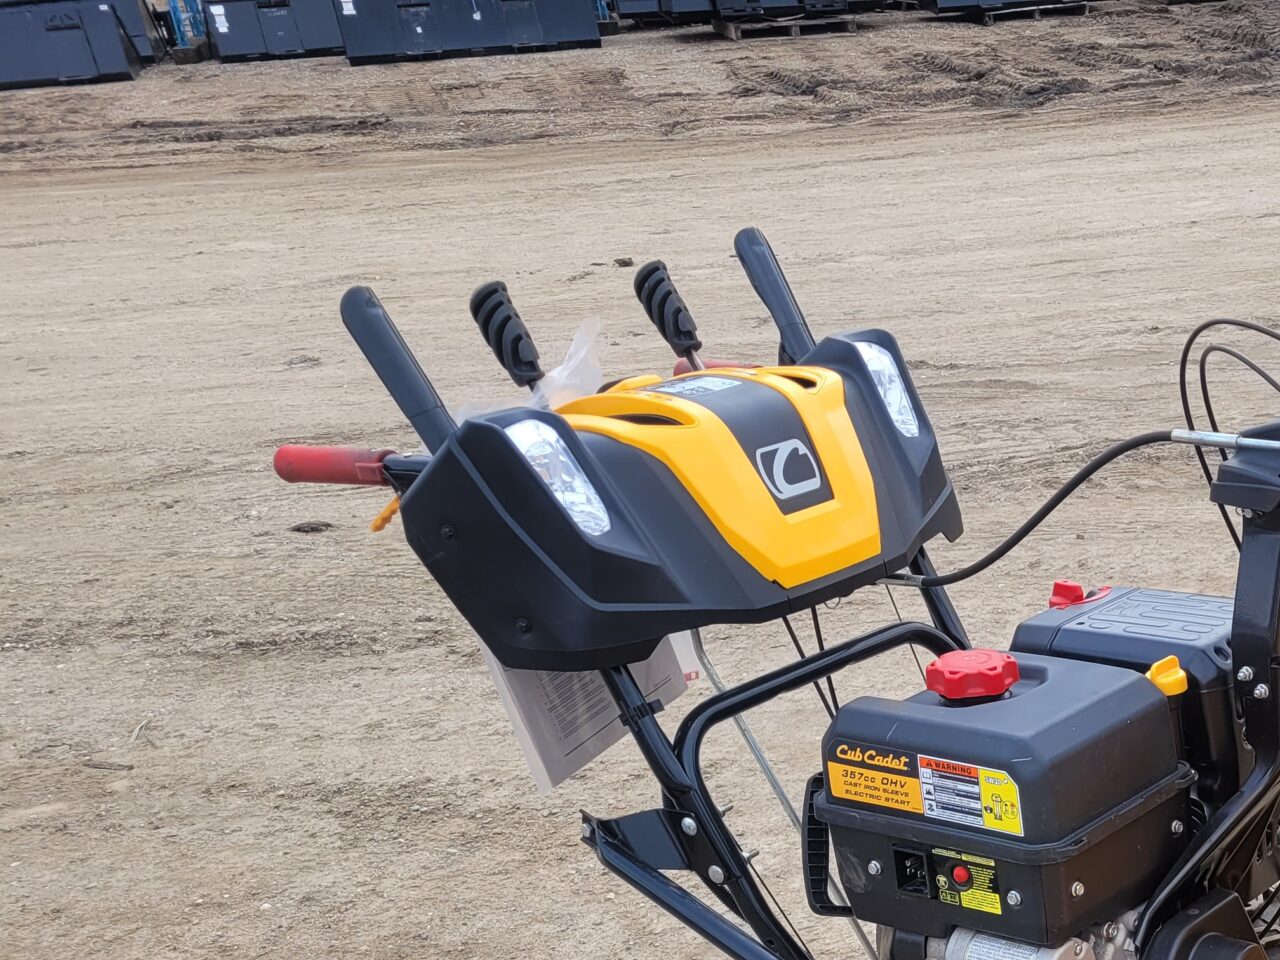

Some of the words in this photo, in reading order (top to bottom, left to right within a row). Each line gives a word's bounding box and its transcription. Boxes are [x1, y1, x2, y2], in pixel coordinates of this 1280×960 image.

[836, 744, 863, 761] Cub
[863, 749, 909, 771] Cadet
[934, 761, 972, 775] WARNING
[841, 769, 876, 784] 357cc
[880, 777, 907, 789] OHV
[843, 780, 862, 789] CAST
[864, 784, 880, 793] IRON
[882, 788, 909, 797] SLEEVE
[845, 789, 882, 801] ELECTRIC
[884, 797, 911, 806] START
